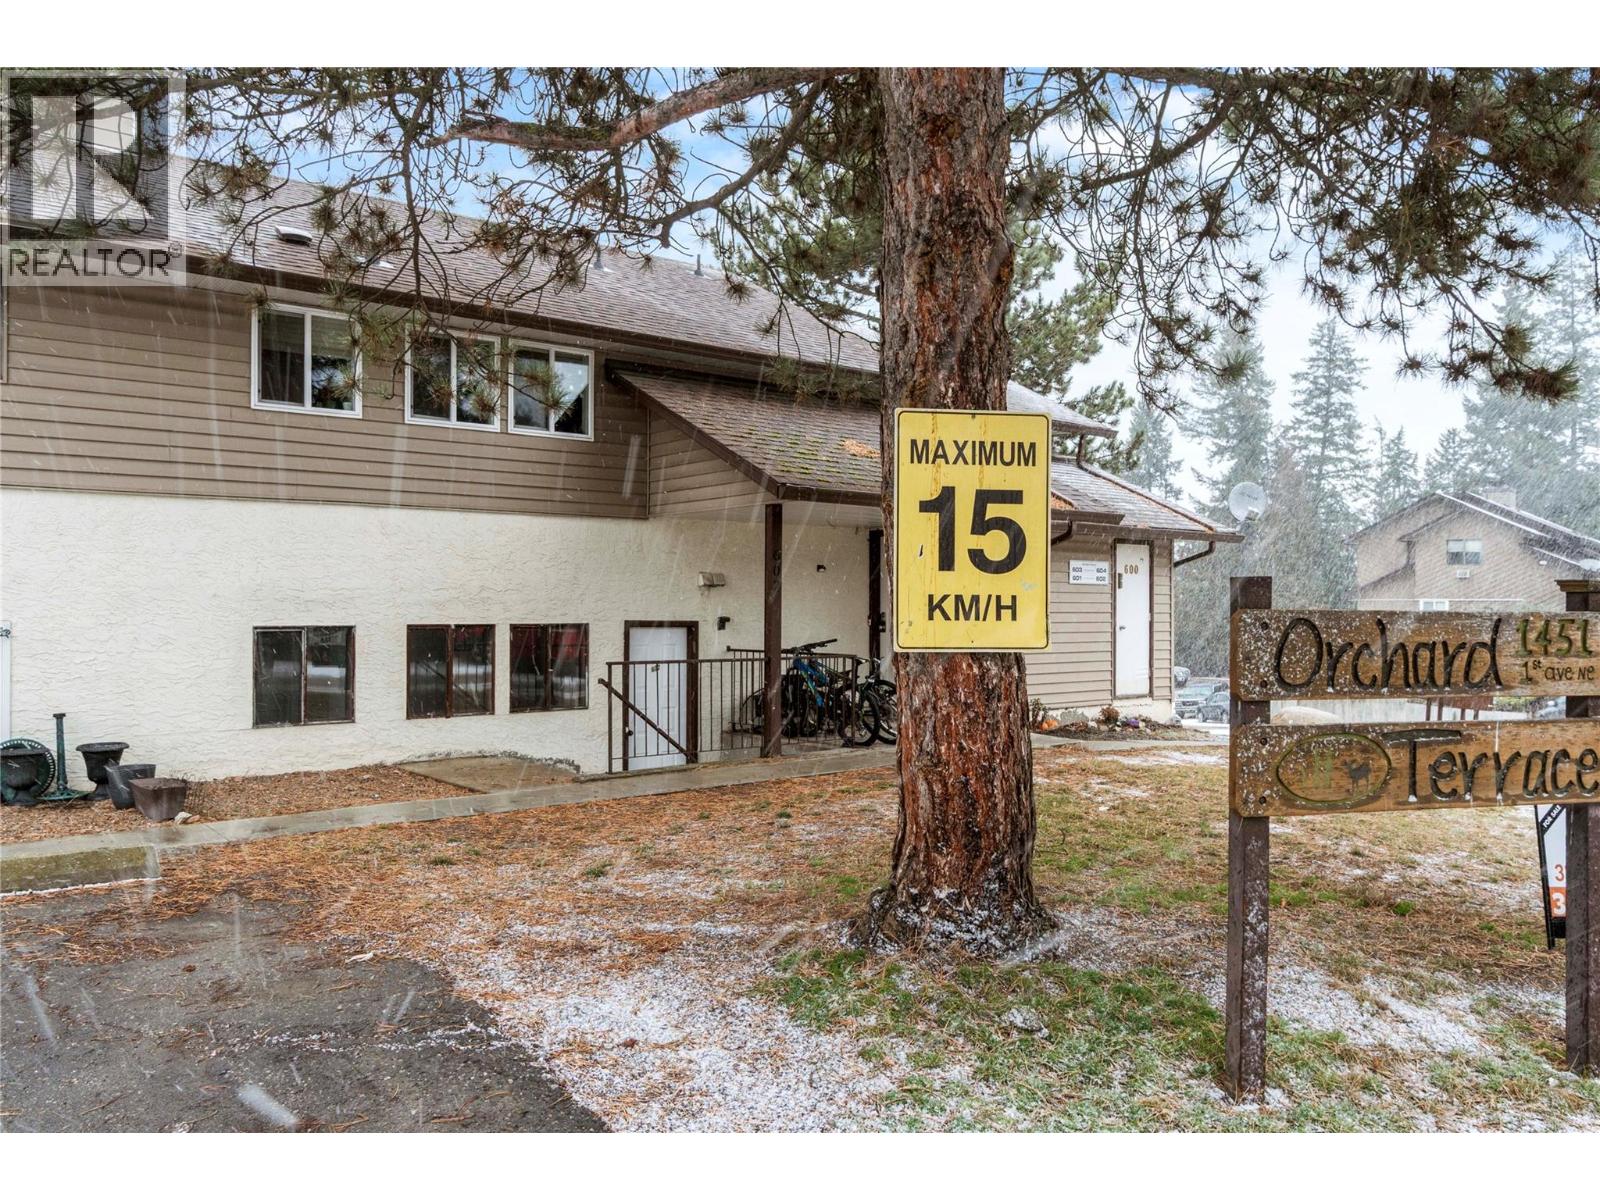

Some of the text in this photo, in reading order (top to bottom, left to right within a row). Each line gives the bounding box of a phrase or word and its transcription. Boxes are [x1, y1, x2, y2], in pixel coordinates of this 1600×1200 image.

[909, 438, 1037, 467] MAXIMUM
[918, 485, 1027, 575] 15
[1124, 564, 1139, 574] 600
[927, 593, 1017, 622] KM/H
[1515, 618, 1593, 656] 1451
[1274, 617, 1503, 691] Orchard
[1519, 660, 1542, 684] 1st
[1382, 728, 1600, 802] Terrace
[1543, 816, 1553, 828] FOR
